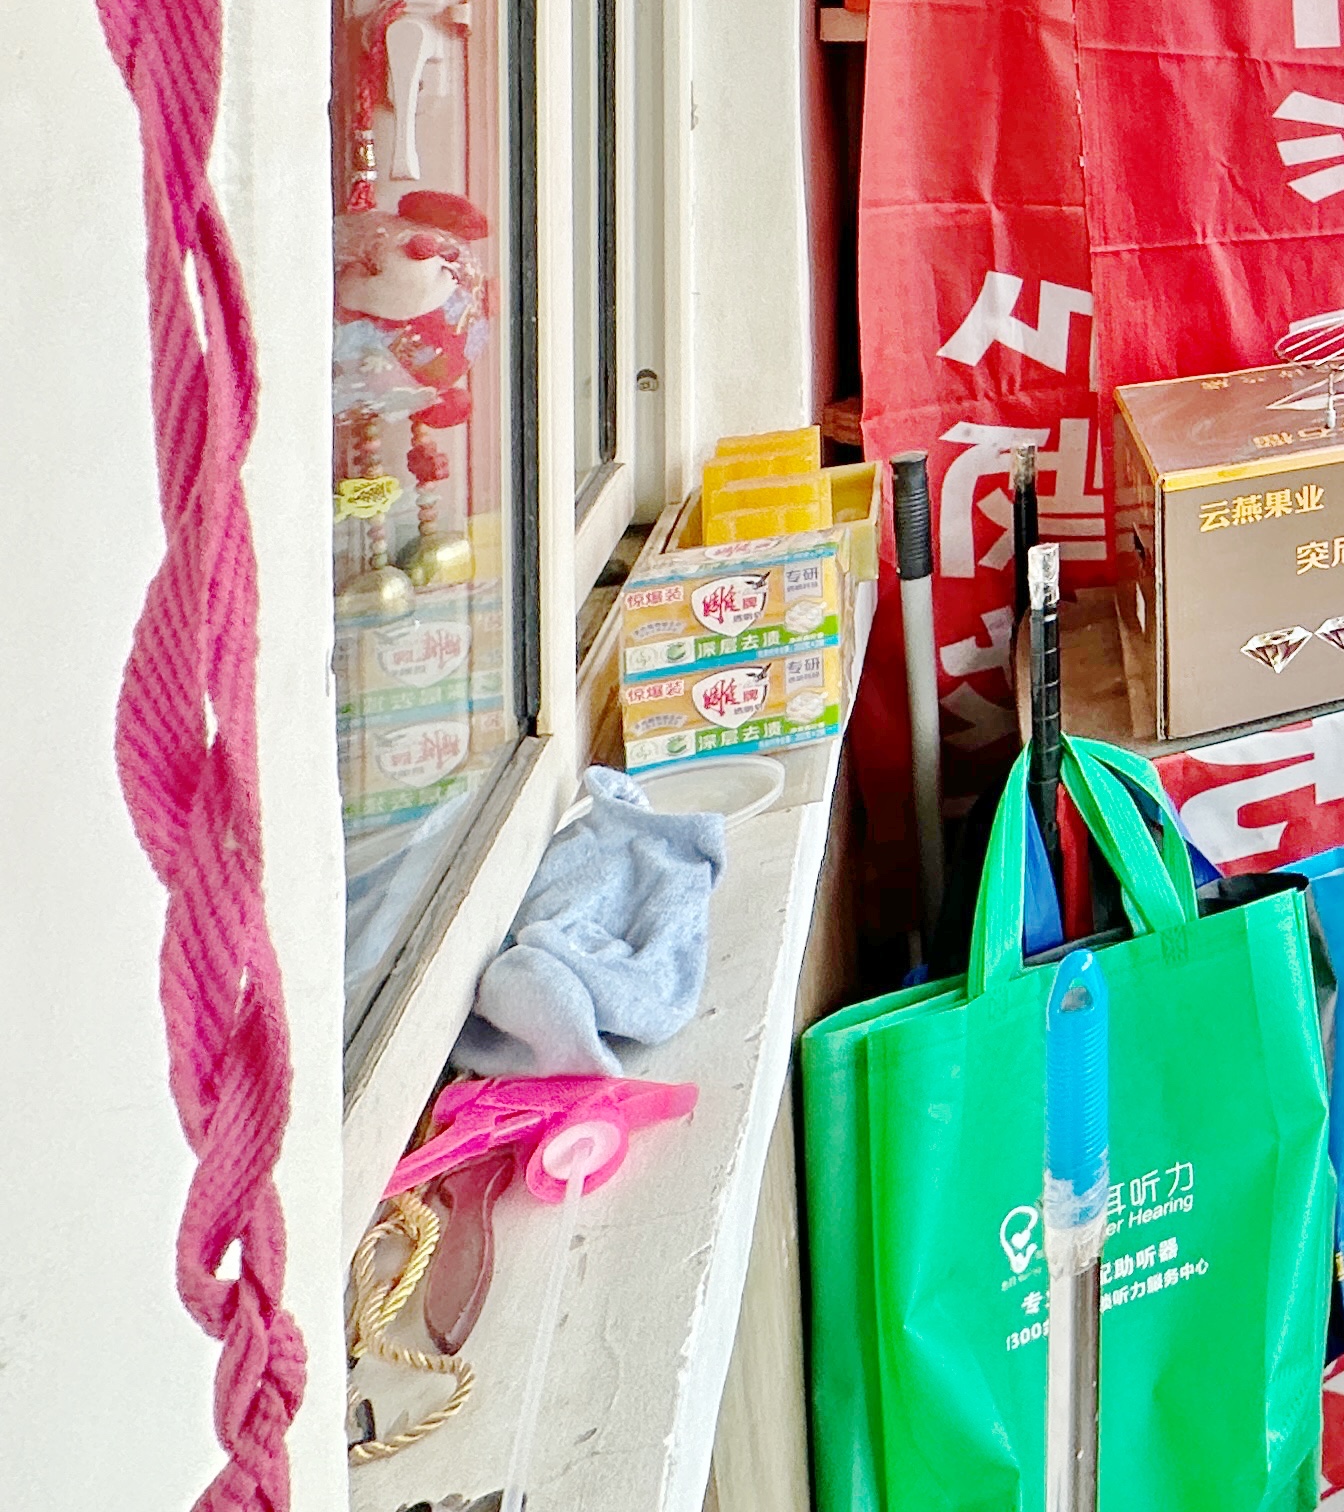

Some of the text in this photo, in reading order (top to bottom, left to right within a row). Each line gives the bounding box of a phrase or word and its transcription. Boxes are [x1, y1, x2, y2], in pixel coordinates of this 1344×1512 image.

[1198, 484, 1326, 533] 云燕果业
[1129, 1194, 1194, 1229] Hearing
